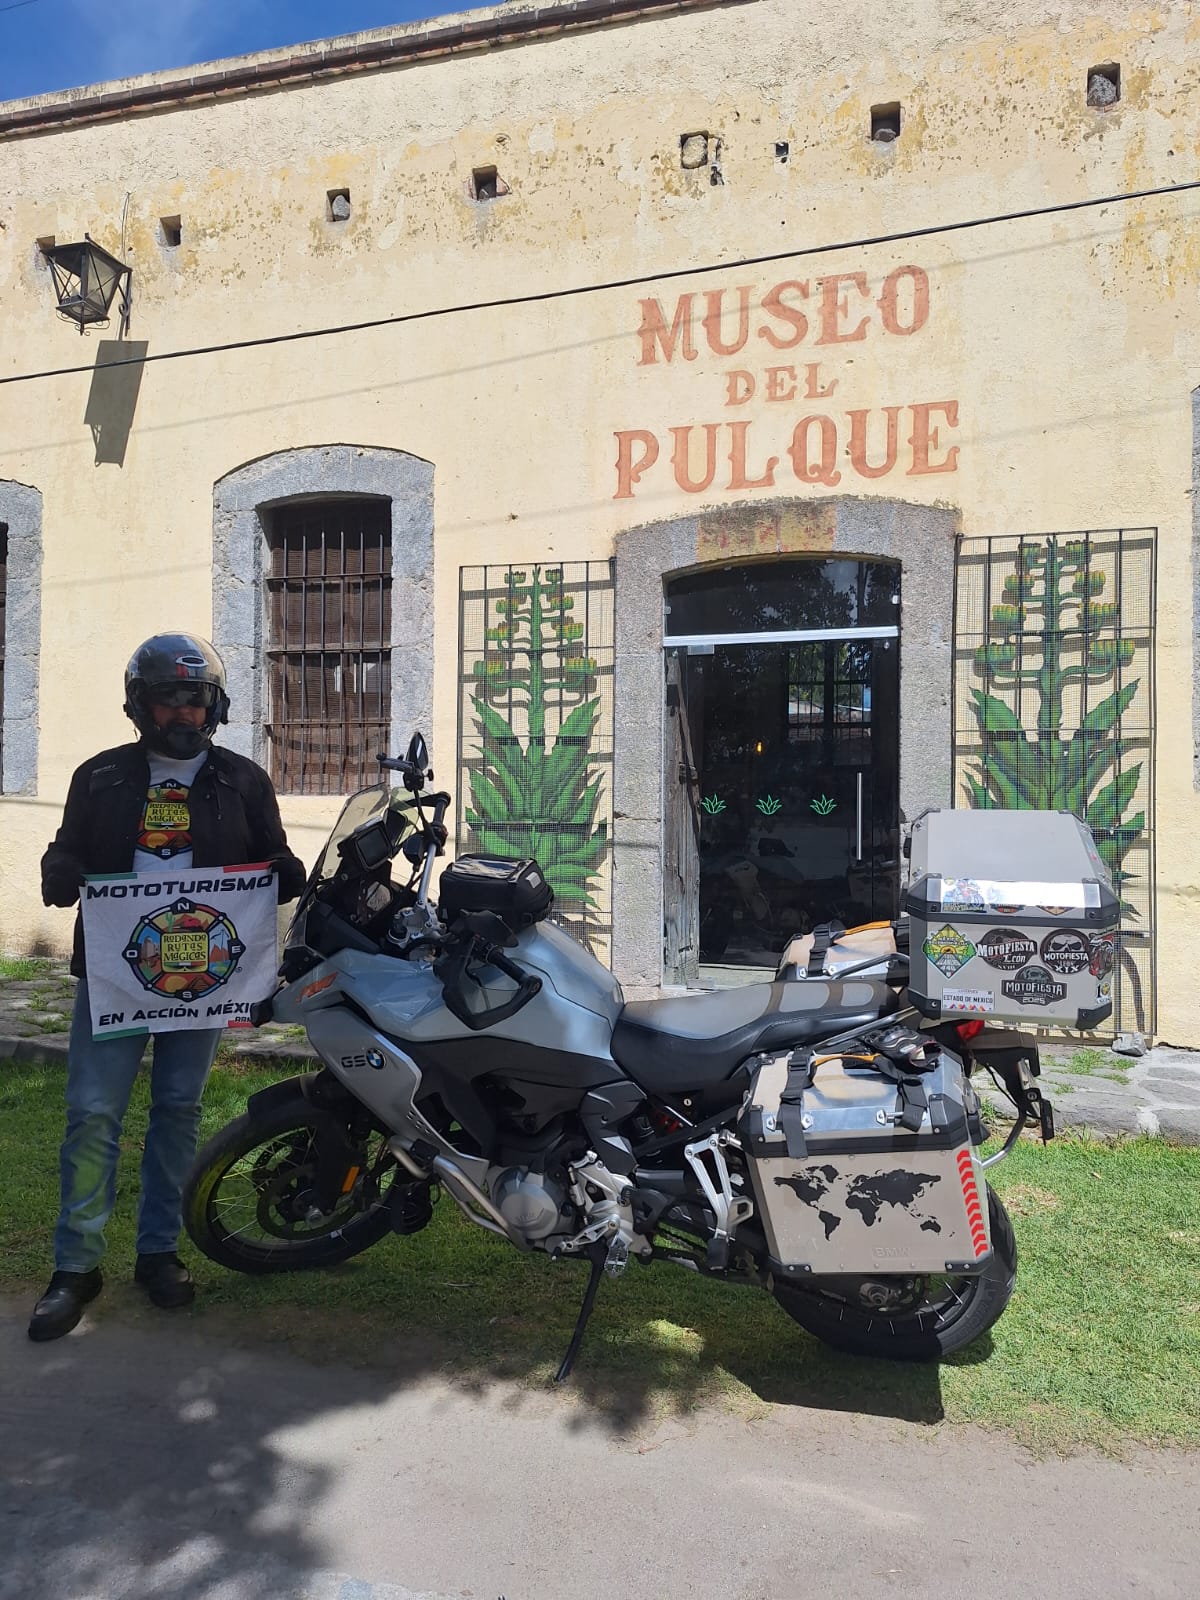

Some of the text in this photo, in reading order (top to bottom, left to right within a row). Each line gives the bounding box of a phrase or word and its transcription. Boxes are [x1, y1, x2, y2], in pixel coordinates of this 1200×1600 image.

[636, 264, 930, 366] MUSEO
[724, 362, 839, 406] DEL
[613, 400, 960, 499] PULQUE
[86, 873, 274, 900] MOTOTURISMO
[177, 902, 190, 911] N
[1044, 952, 1089, 961] MOTOFIESTA
[1006, 981, 1063, 996] MOTOFIESTA
[99, 1013, 124, 1026] EN
[132, 1004, 198, 1021] ACCIÓN
[341, 1054, 366, 1068] GS
